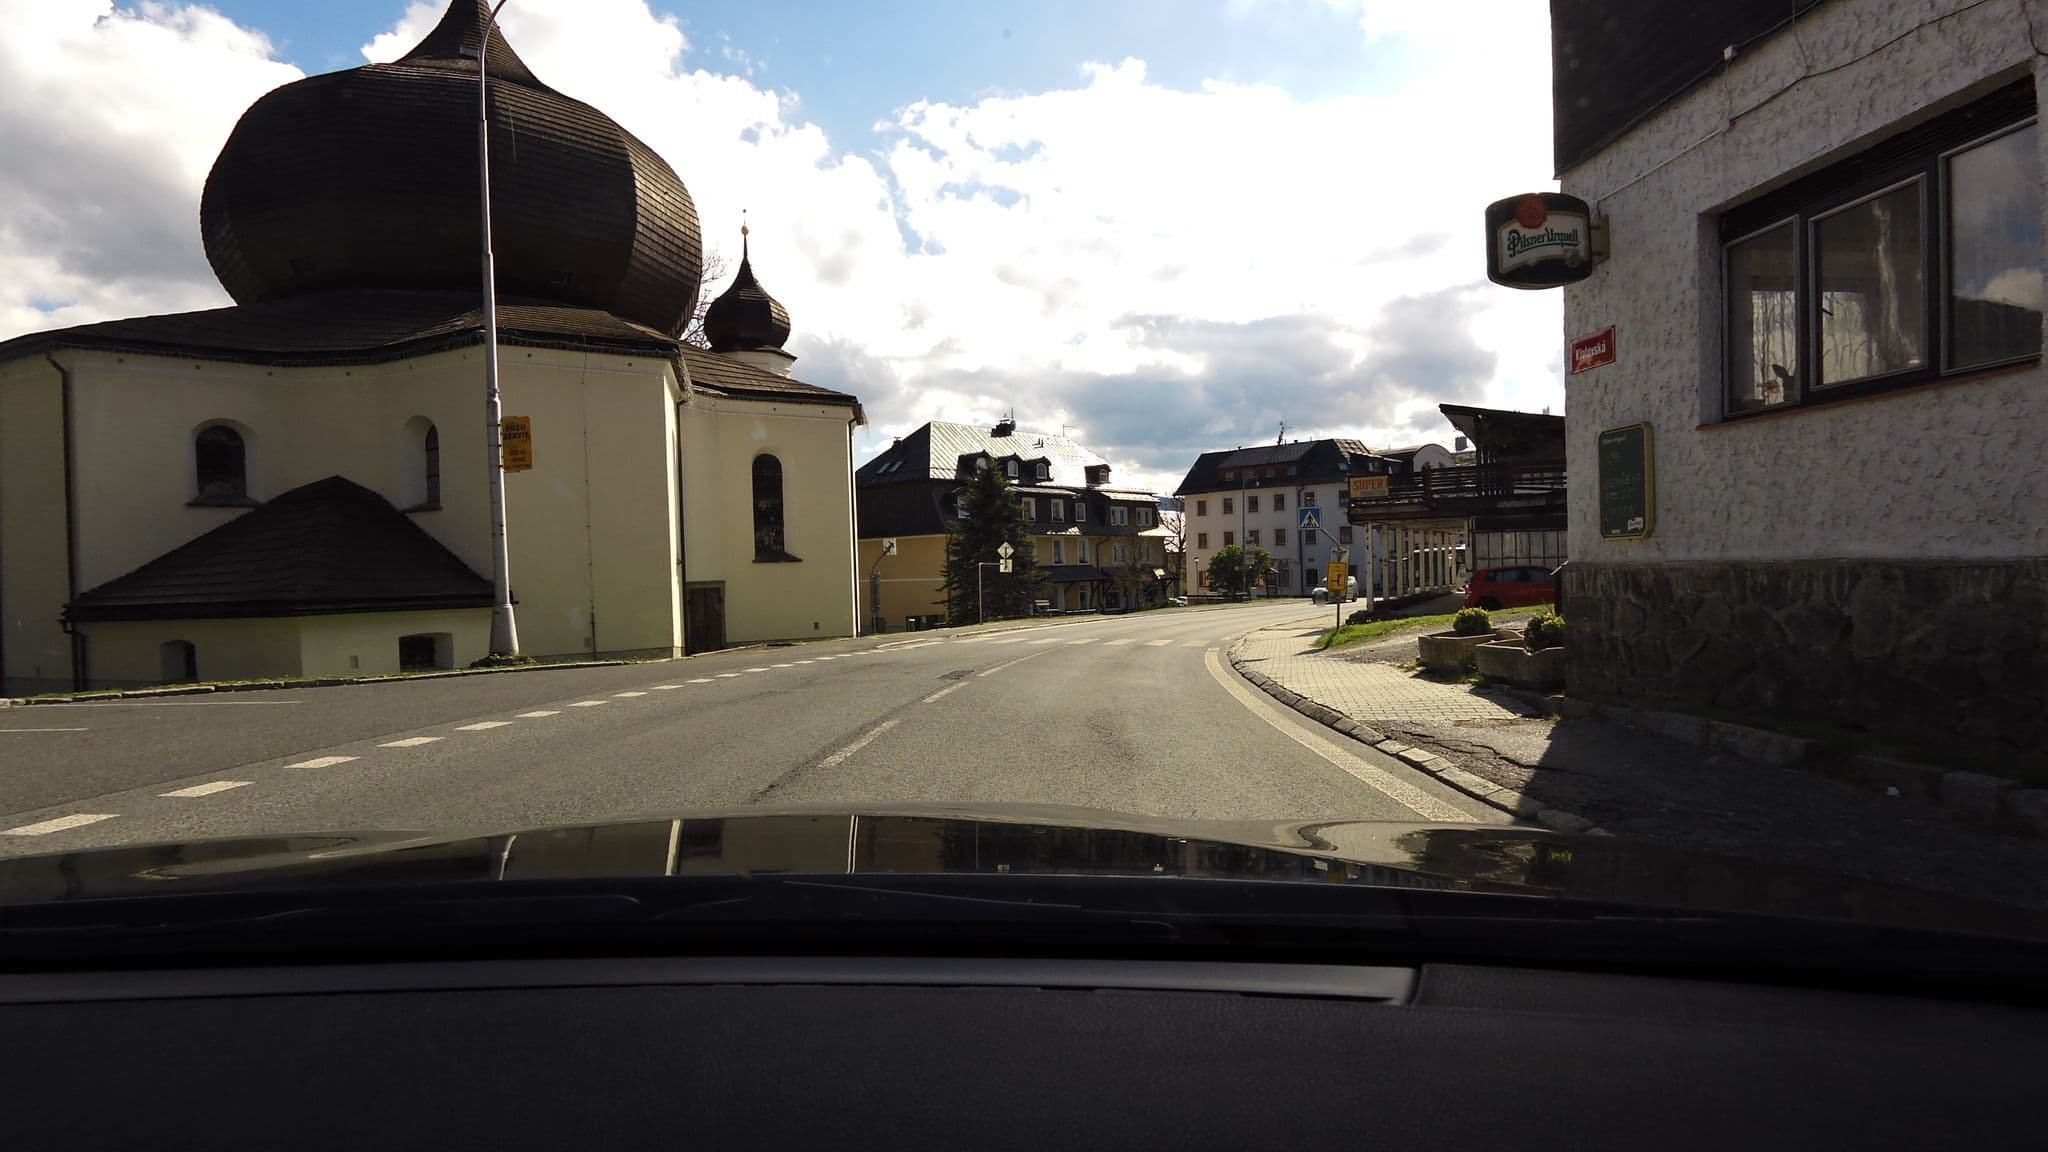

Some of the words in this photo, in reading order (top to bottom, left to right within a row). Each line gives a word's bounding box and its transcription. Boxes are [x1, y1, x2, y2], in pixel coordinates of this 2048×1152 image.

[1507, 229, 1546, 258] Pilsner
[1545, 227, 1579, 247] Urquell
[505, 423, 527, 432] PNEU
